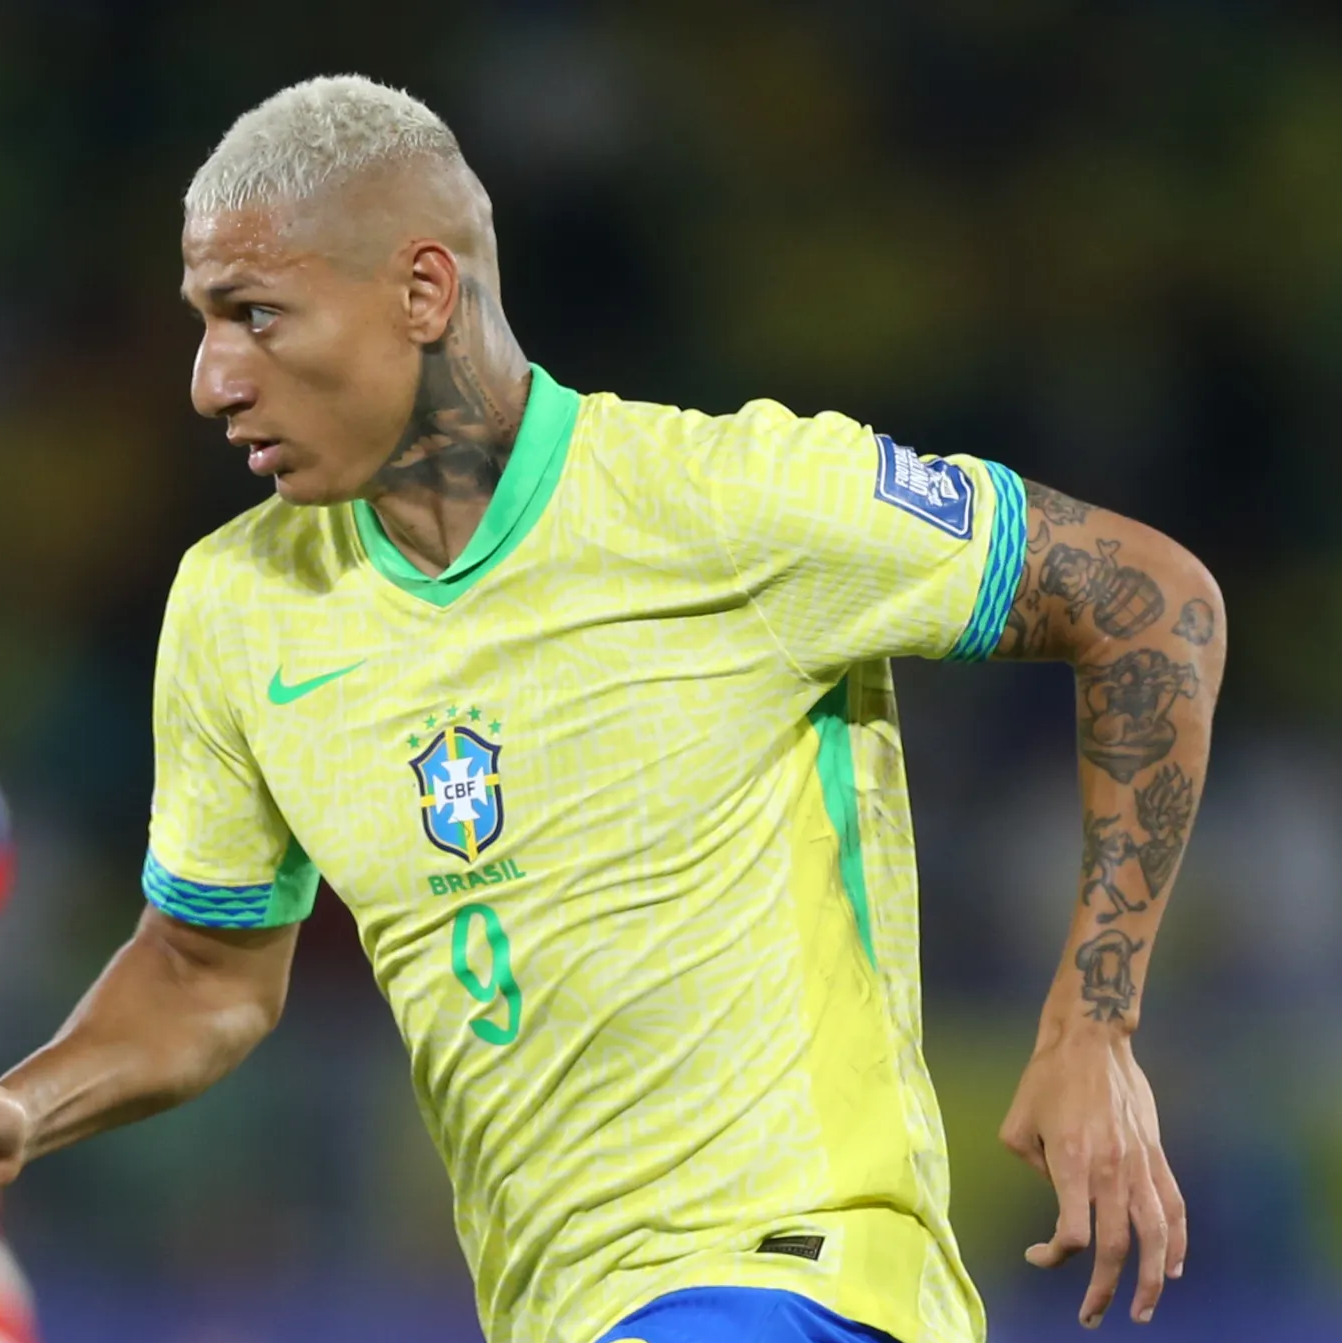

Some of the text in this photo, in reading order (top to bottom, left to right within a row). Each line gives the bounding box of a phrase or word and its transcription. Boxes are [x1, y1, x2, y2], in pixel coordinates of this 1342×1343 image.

[444, 780, 476, 800] CBF
[428, 858, 526, 896] BRASIL
[451, 902, 523, 1047] 9
